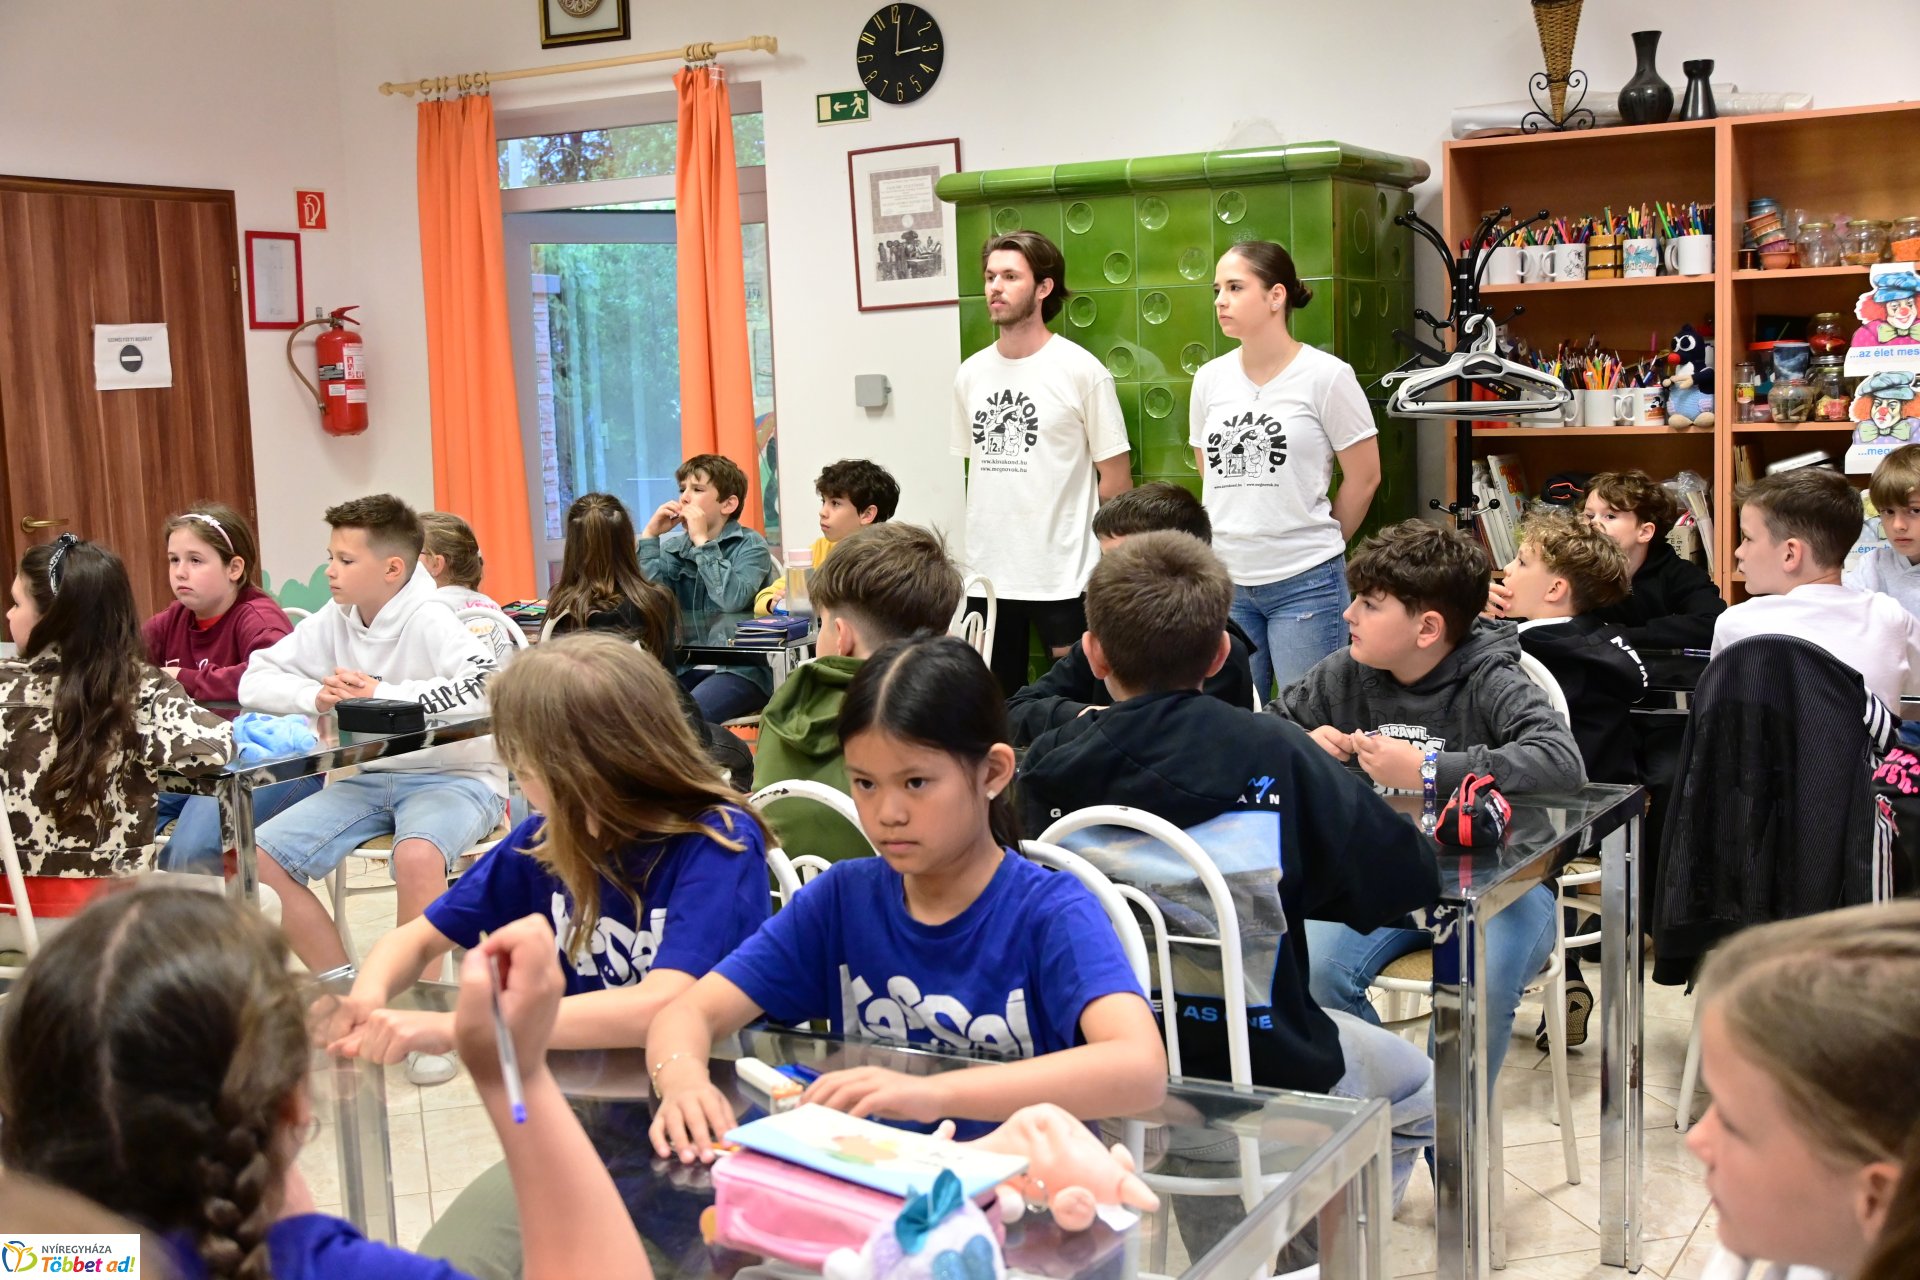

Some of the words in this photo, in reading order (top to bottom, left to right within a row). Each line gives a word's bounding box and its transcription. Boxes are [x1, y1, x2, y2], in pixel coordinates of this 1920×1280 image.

[872, 14, 886, 31] 11
[917, 21, 932, 36] 2
[860, 31, 876, 46] 10
[921, 43, 939, 52] 3
[857, 54, 874, 63] 9
[919, 63, 935, 74] 4
[863, 70, 878, 85] 8
[909, 74, 922, 93] 5
[879, 79, 889, 97] 7
[896, 82, 904, 102] 6
[1874, 348, 1894, 357] élet
[972, 410, 988, 445] KIS
[986, 389, 1039, 447] VAKOND
[1206, 432, 1222, 469] KIS
[1222, 411, 1287, 466] VAKOND
[1379, 724, 1428, 740] BRAWL
